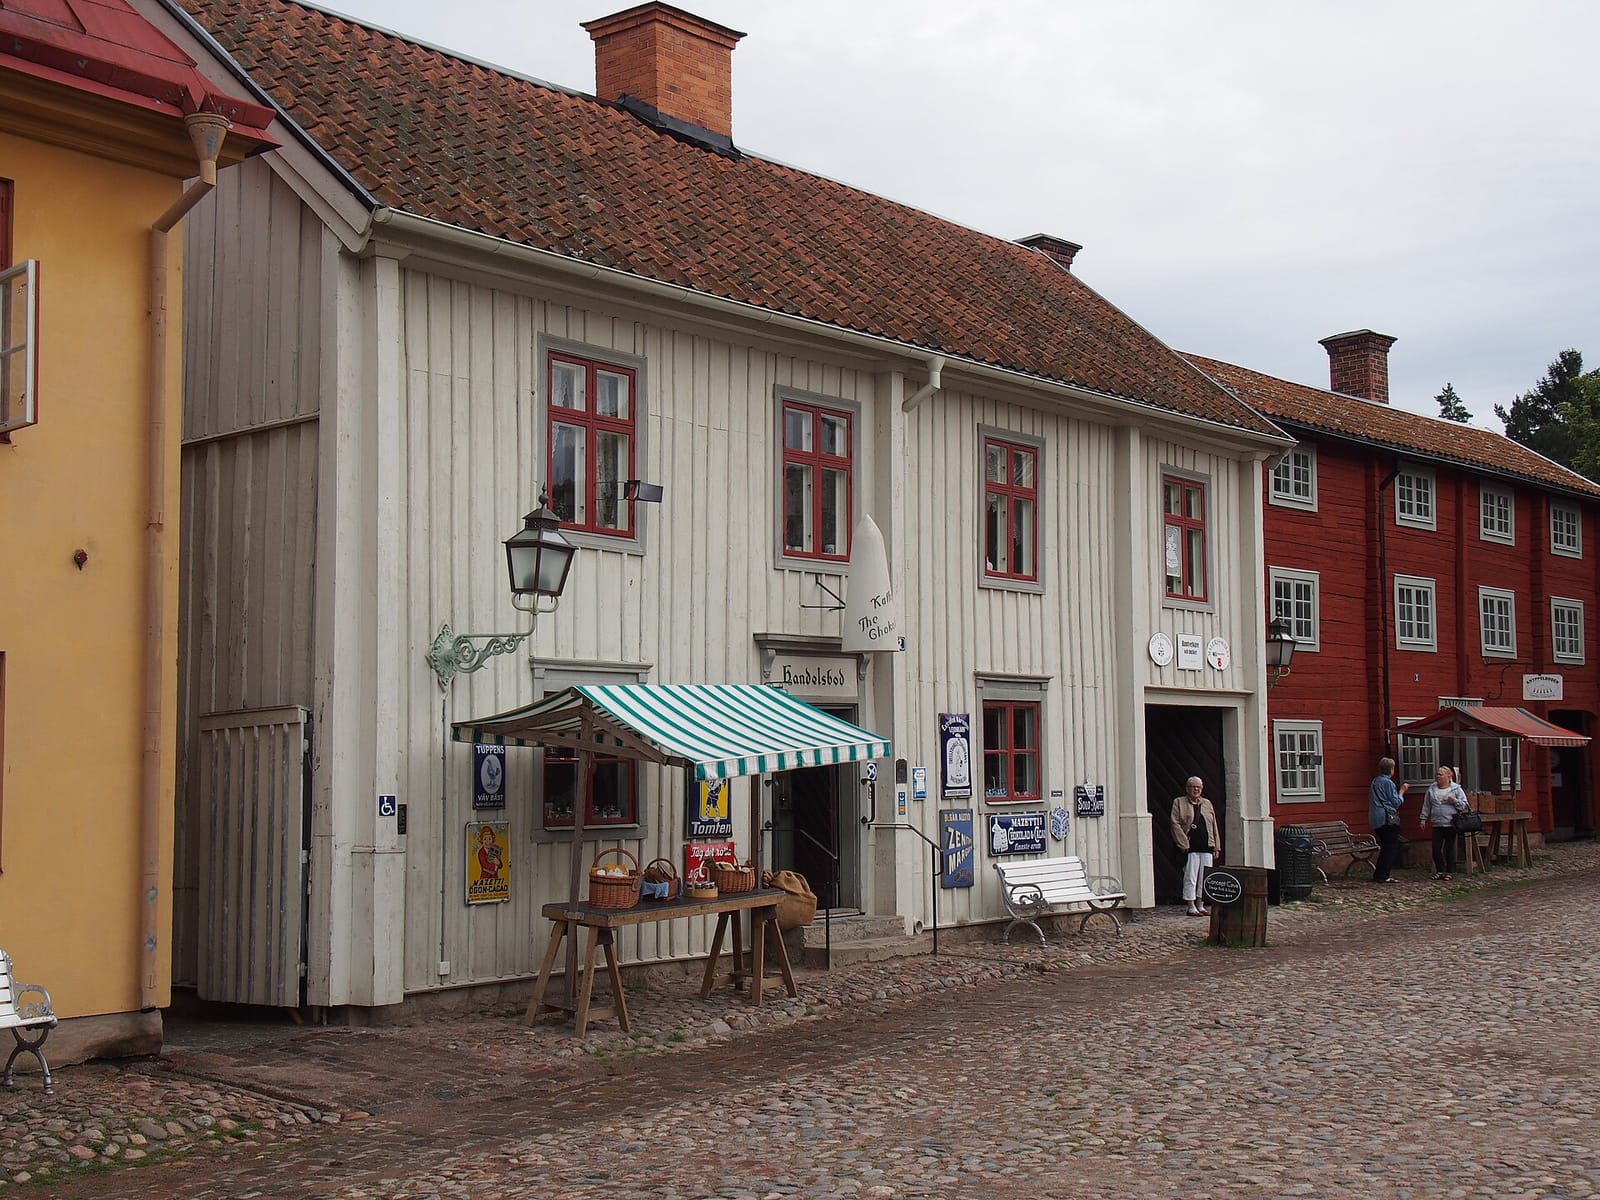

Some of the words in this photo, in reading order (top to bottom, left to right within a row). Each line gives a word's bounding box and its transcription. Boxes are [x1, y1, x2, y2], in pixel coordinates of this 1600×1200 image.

[783, 664, 845, 686] Handelsbod
[476, 745, 505, 754] TUPPENS
[691, 822, 731, 835] Tomten
